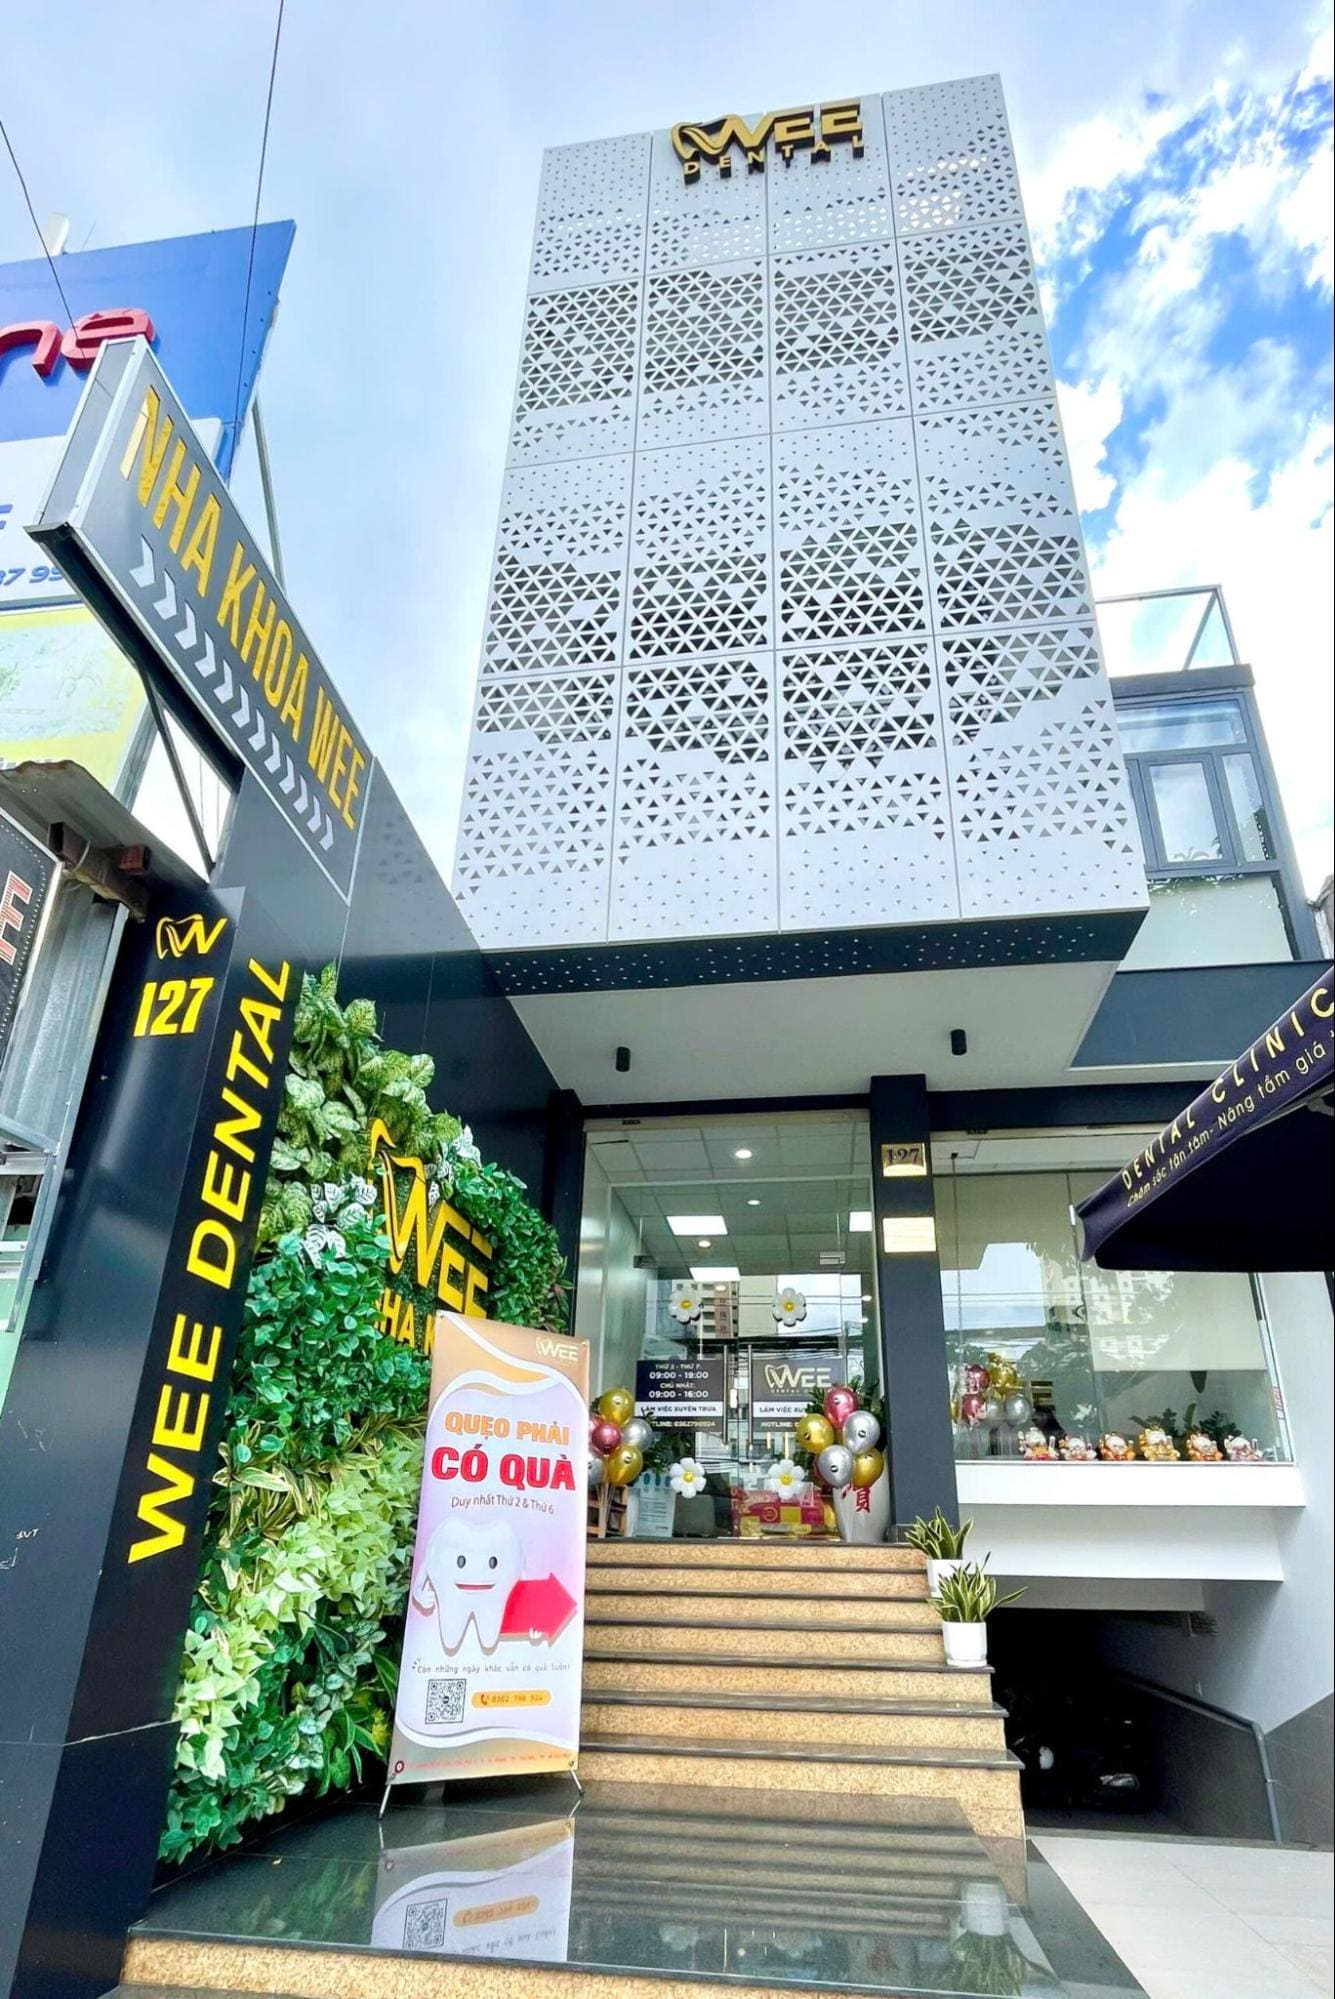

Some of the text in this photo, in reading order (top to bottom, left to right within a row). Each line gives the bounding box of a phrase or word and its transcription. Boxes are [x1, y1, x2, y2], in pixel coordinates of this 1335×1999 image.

[670, 97, 863, 160] WEE
[684, 135, 865, 182] DENTAL
[120, 384, 366, 831] NHA KHOA WEE
[133, 976, 214, 1038] 127
[1122, 987, 1334, 1190] DENTAL CLINIC
[1217, 1095, 1255, 1130] Nâng
[1295, 1040, 1326, 1075] giá
[128, 958, 291, 1563] WEE DENTAL
[535, 1336, 579, 1362] WEE
[648, 1390, 676, 1398] 09:00
[684, 1390, 709, 1398] 16:00
[649, 1371, 677, 1379] 09:00
[684, 1371, 709, 1379] 19:00
[765, 1363, 832, 1389] WEE
[444, 1411, 511, 1440] QUẸO
[431, 1443, 577, 1491] CÓ QUÀ
[451, 1496, 471, 1509] Duy
[473, 1493, 495, 1505] nhất
[514, 1496, 520, 1507] 2
[522, 1498, 529, 1508] &
[548, 1503, 554, 1515] 6
